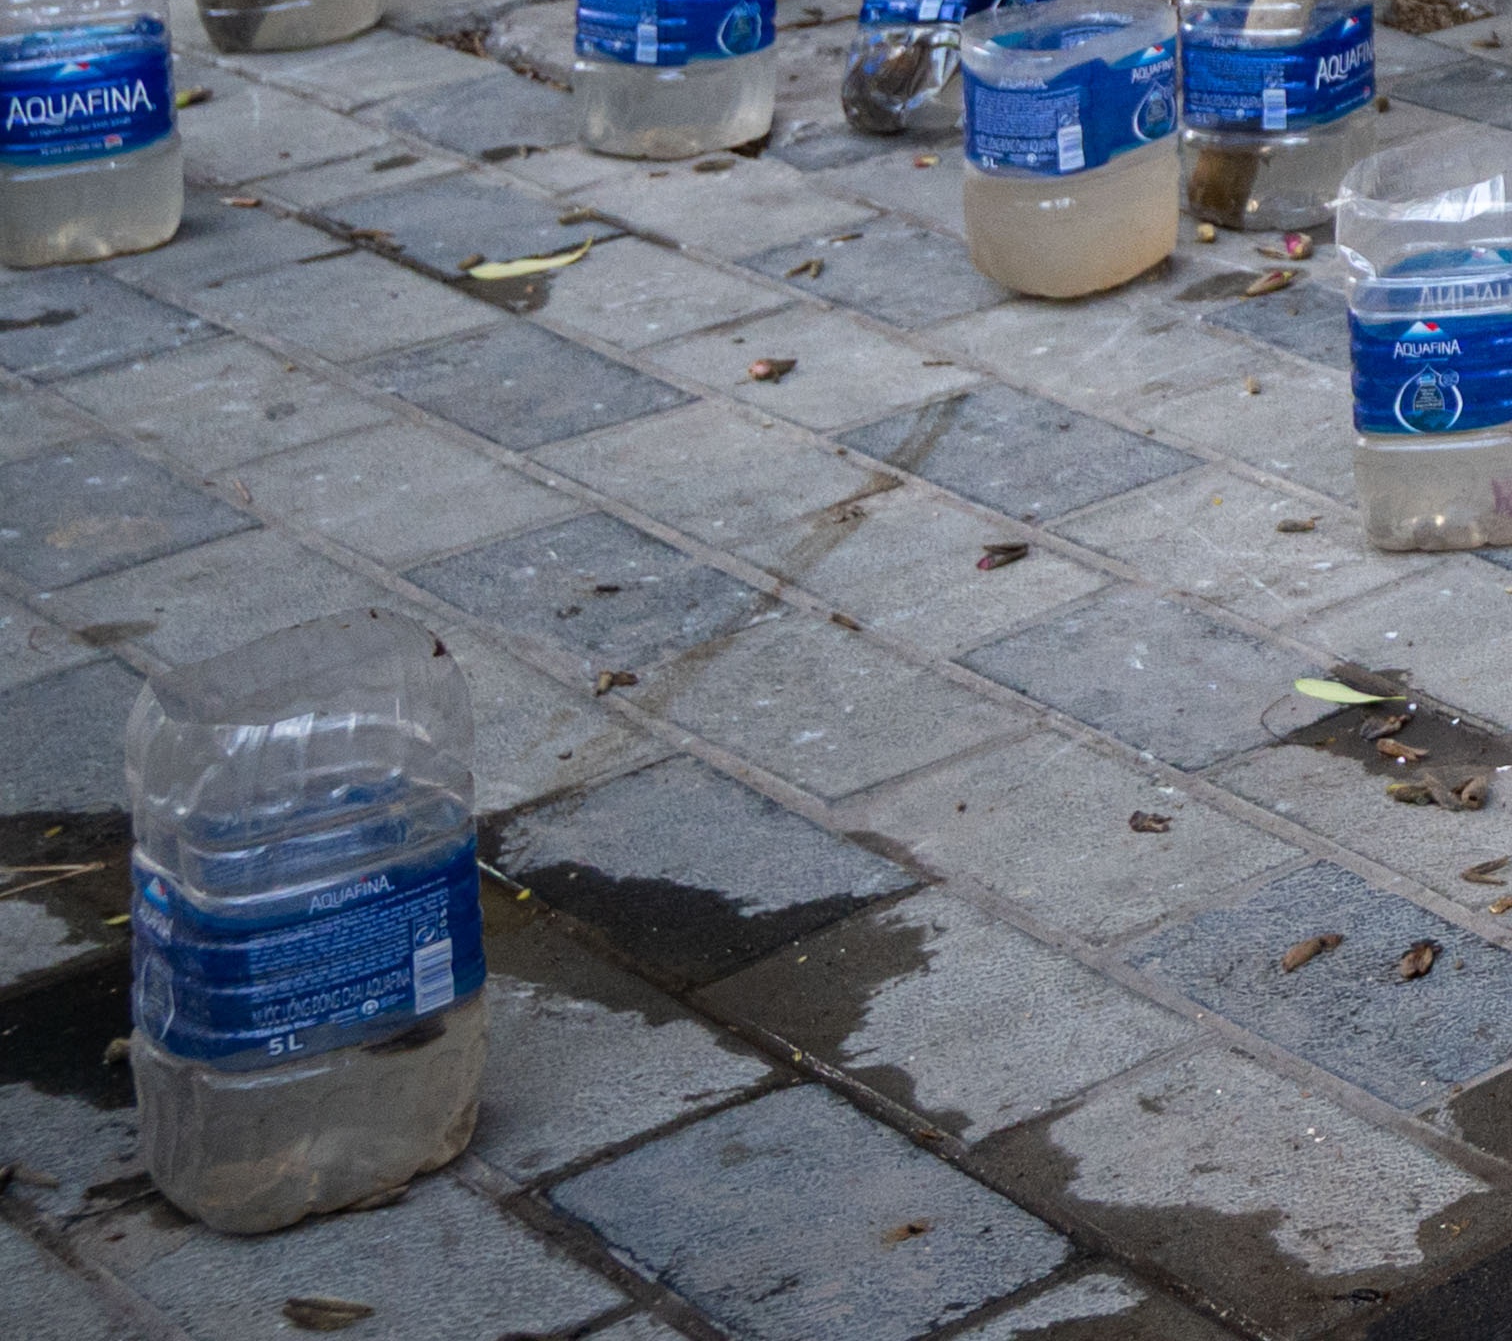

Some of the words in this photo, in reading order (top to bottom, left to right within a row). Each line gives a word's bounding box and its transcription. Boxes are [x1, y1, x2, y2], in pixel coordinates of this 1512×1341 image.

[5, 79, 156, 132] AQUAFINA
[1393, 337, 1464, 360] AQUAFINA
[308, 874, 396, 915] AQUAFINA
[269, 1036, 284, 1057] 5
[288, 1033, 304, 1052] L
